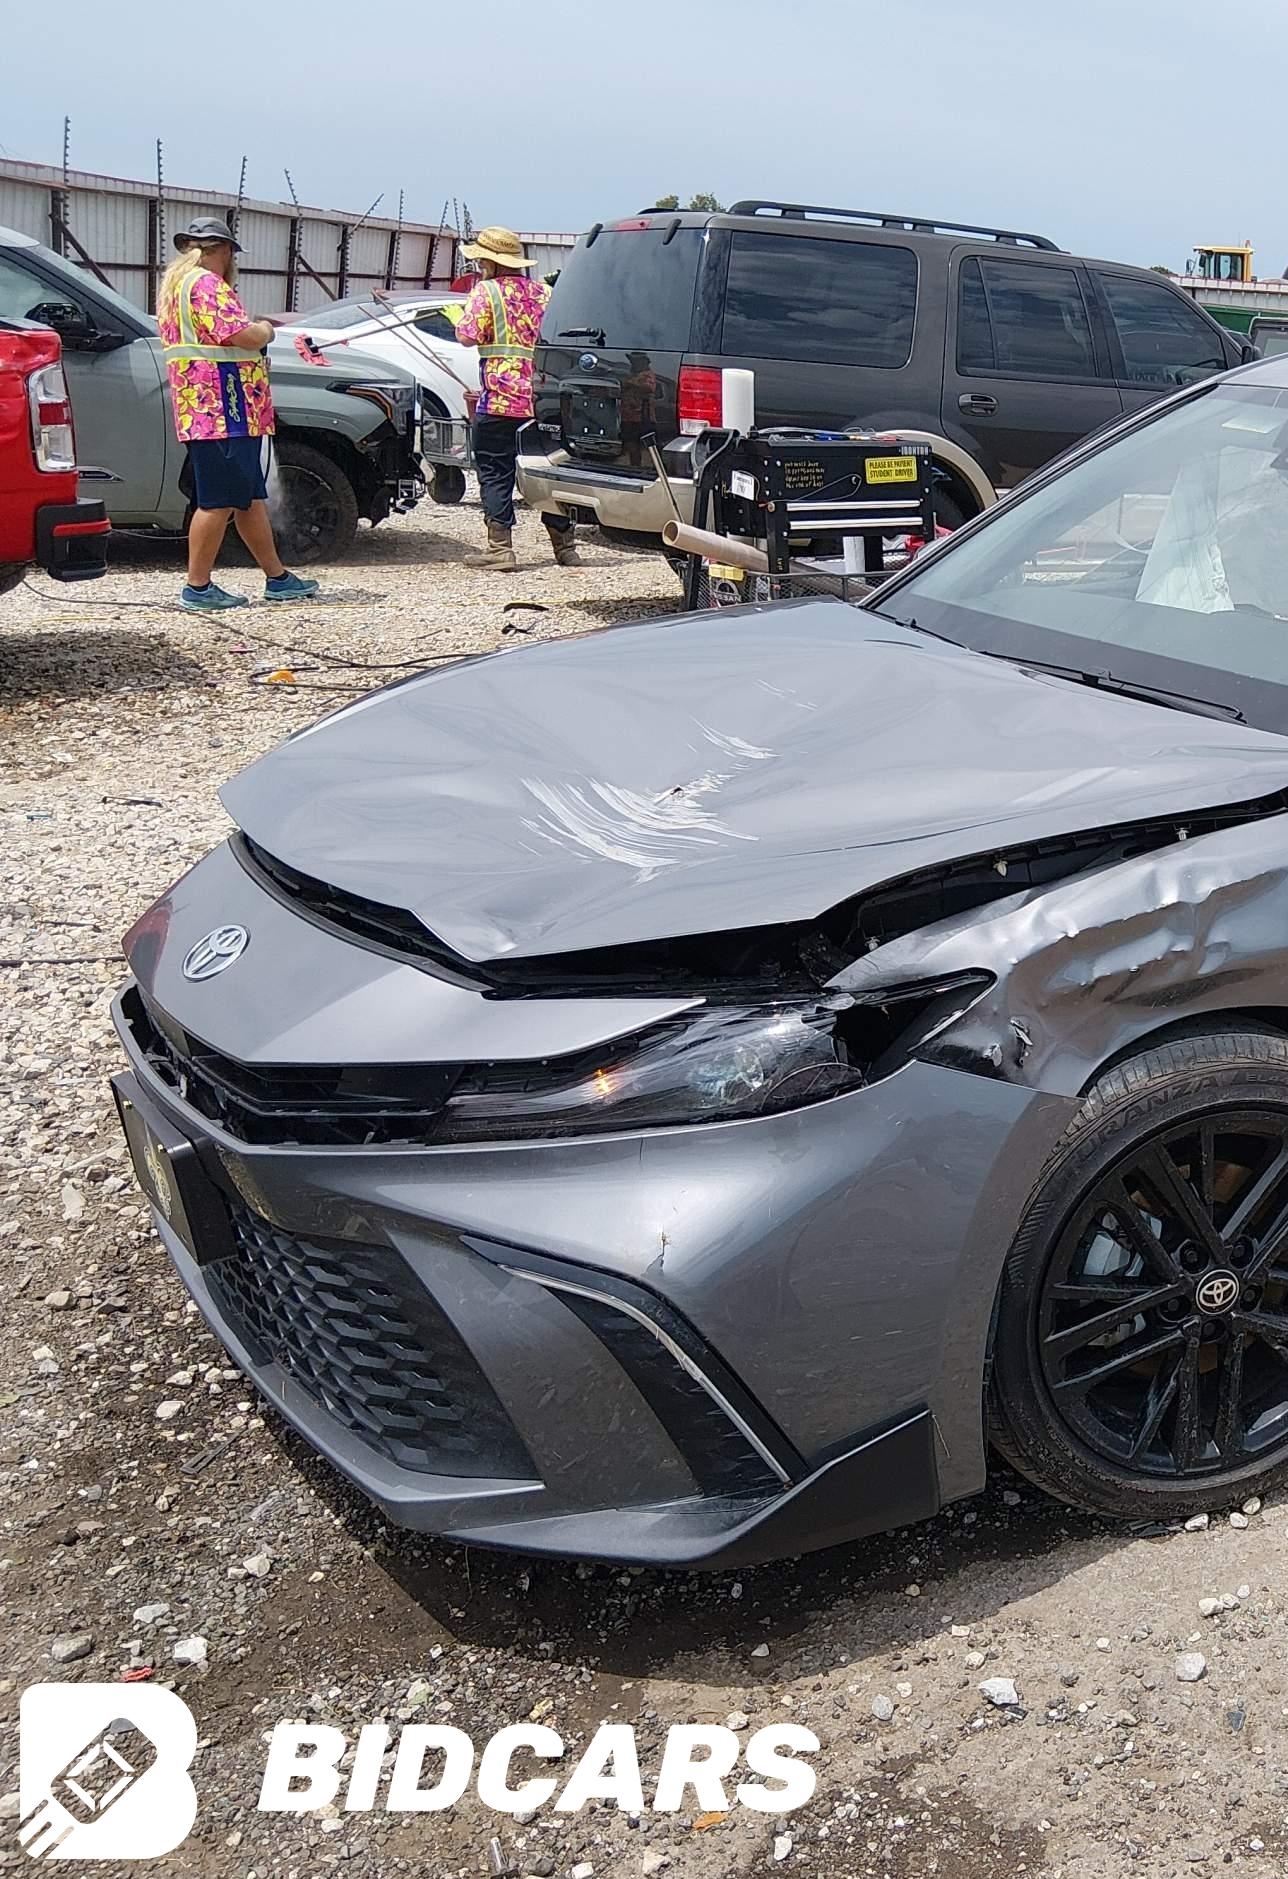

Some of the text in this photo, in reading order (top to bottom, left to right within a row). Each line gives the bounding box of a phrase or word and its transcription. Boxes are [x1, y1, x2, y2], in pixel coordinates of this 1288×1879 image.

[869, 460, 913, 470] PLEASE BE PATIENT
[869, 468, 914, 479] STUDENT DRIVER
